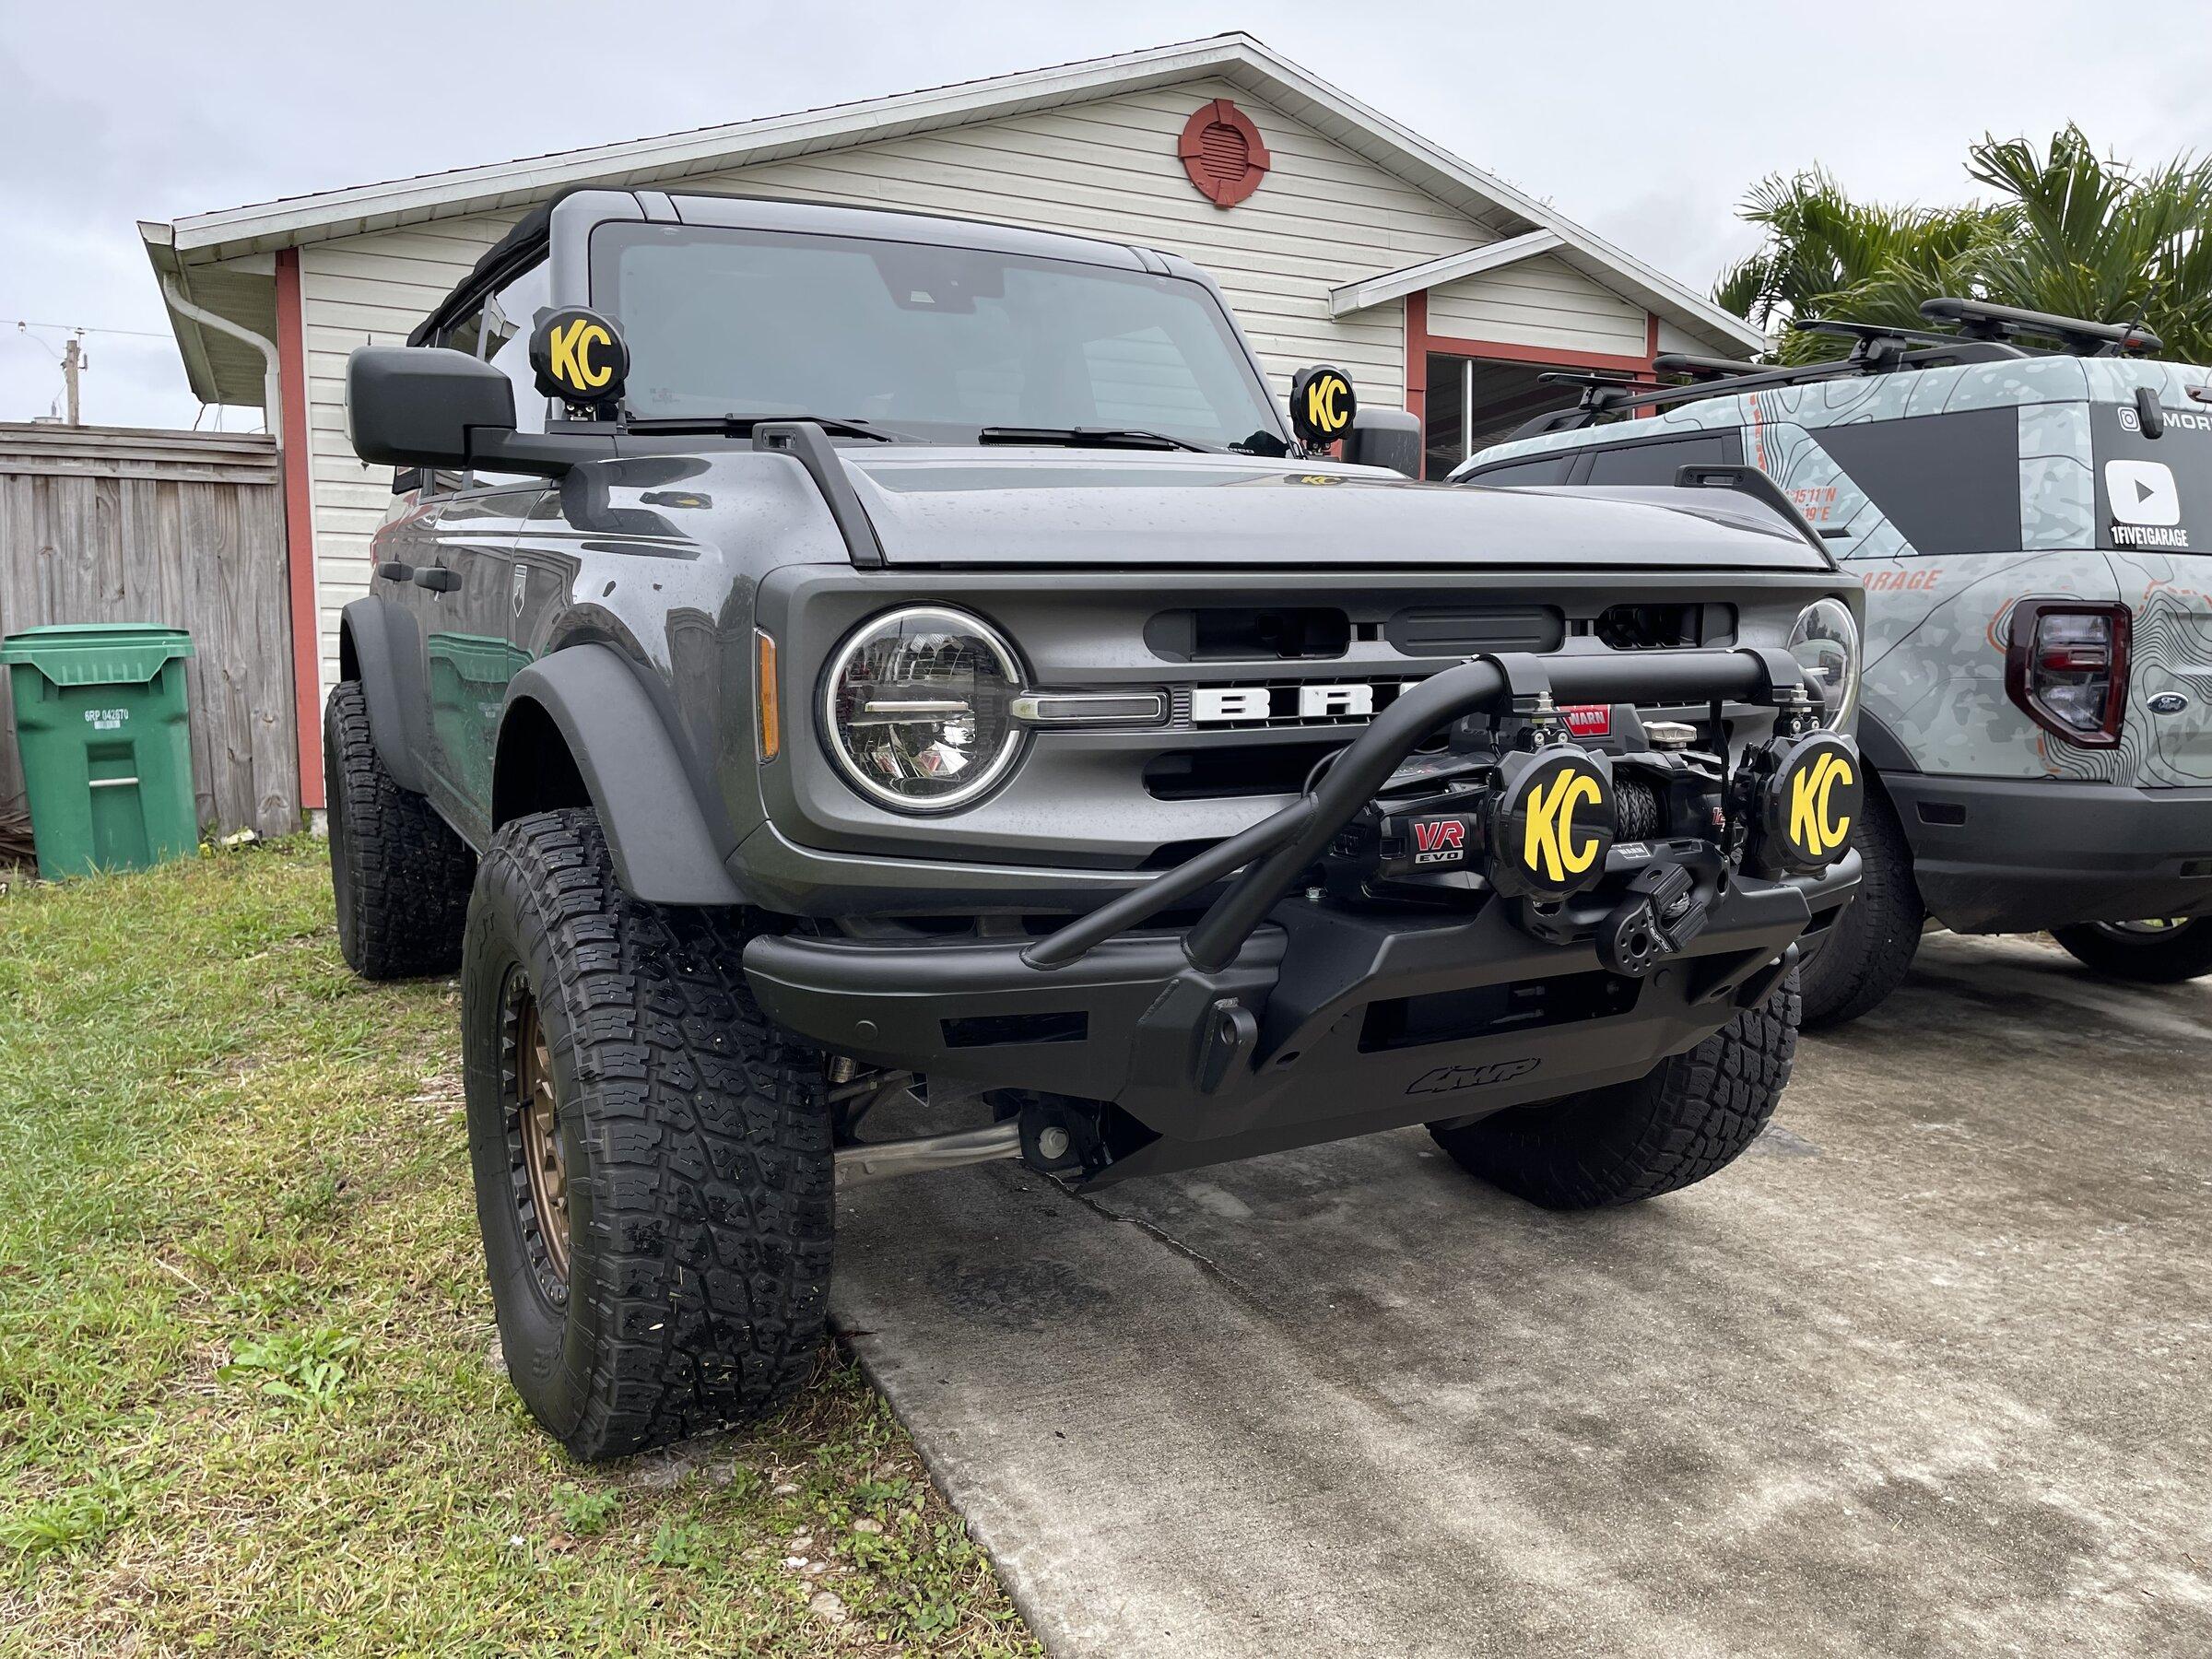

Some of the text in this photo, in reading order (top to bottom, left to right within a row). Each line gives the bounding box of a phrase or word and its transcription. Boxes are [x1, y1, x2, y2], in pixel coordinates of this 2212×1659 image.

[550, 319, 612, 391] KC
[1308, 375, 1348, 432] KC
[2161, 411, 2212, 430] MOR
[2111, 525, 2189, 547] 1FIVE1GARAGE
[1192, 682, 1420, 722] BR
[1568, 711, 1606, 726] WARN
[1789, 752, 1853, 855] KC
[1415, 820, 1465, 851] VR
[1524, 768, 1603, 882] KC
[1419, 852, 1459, 862] EVO
